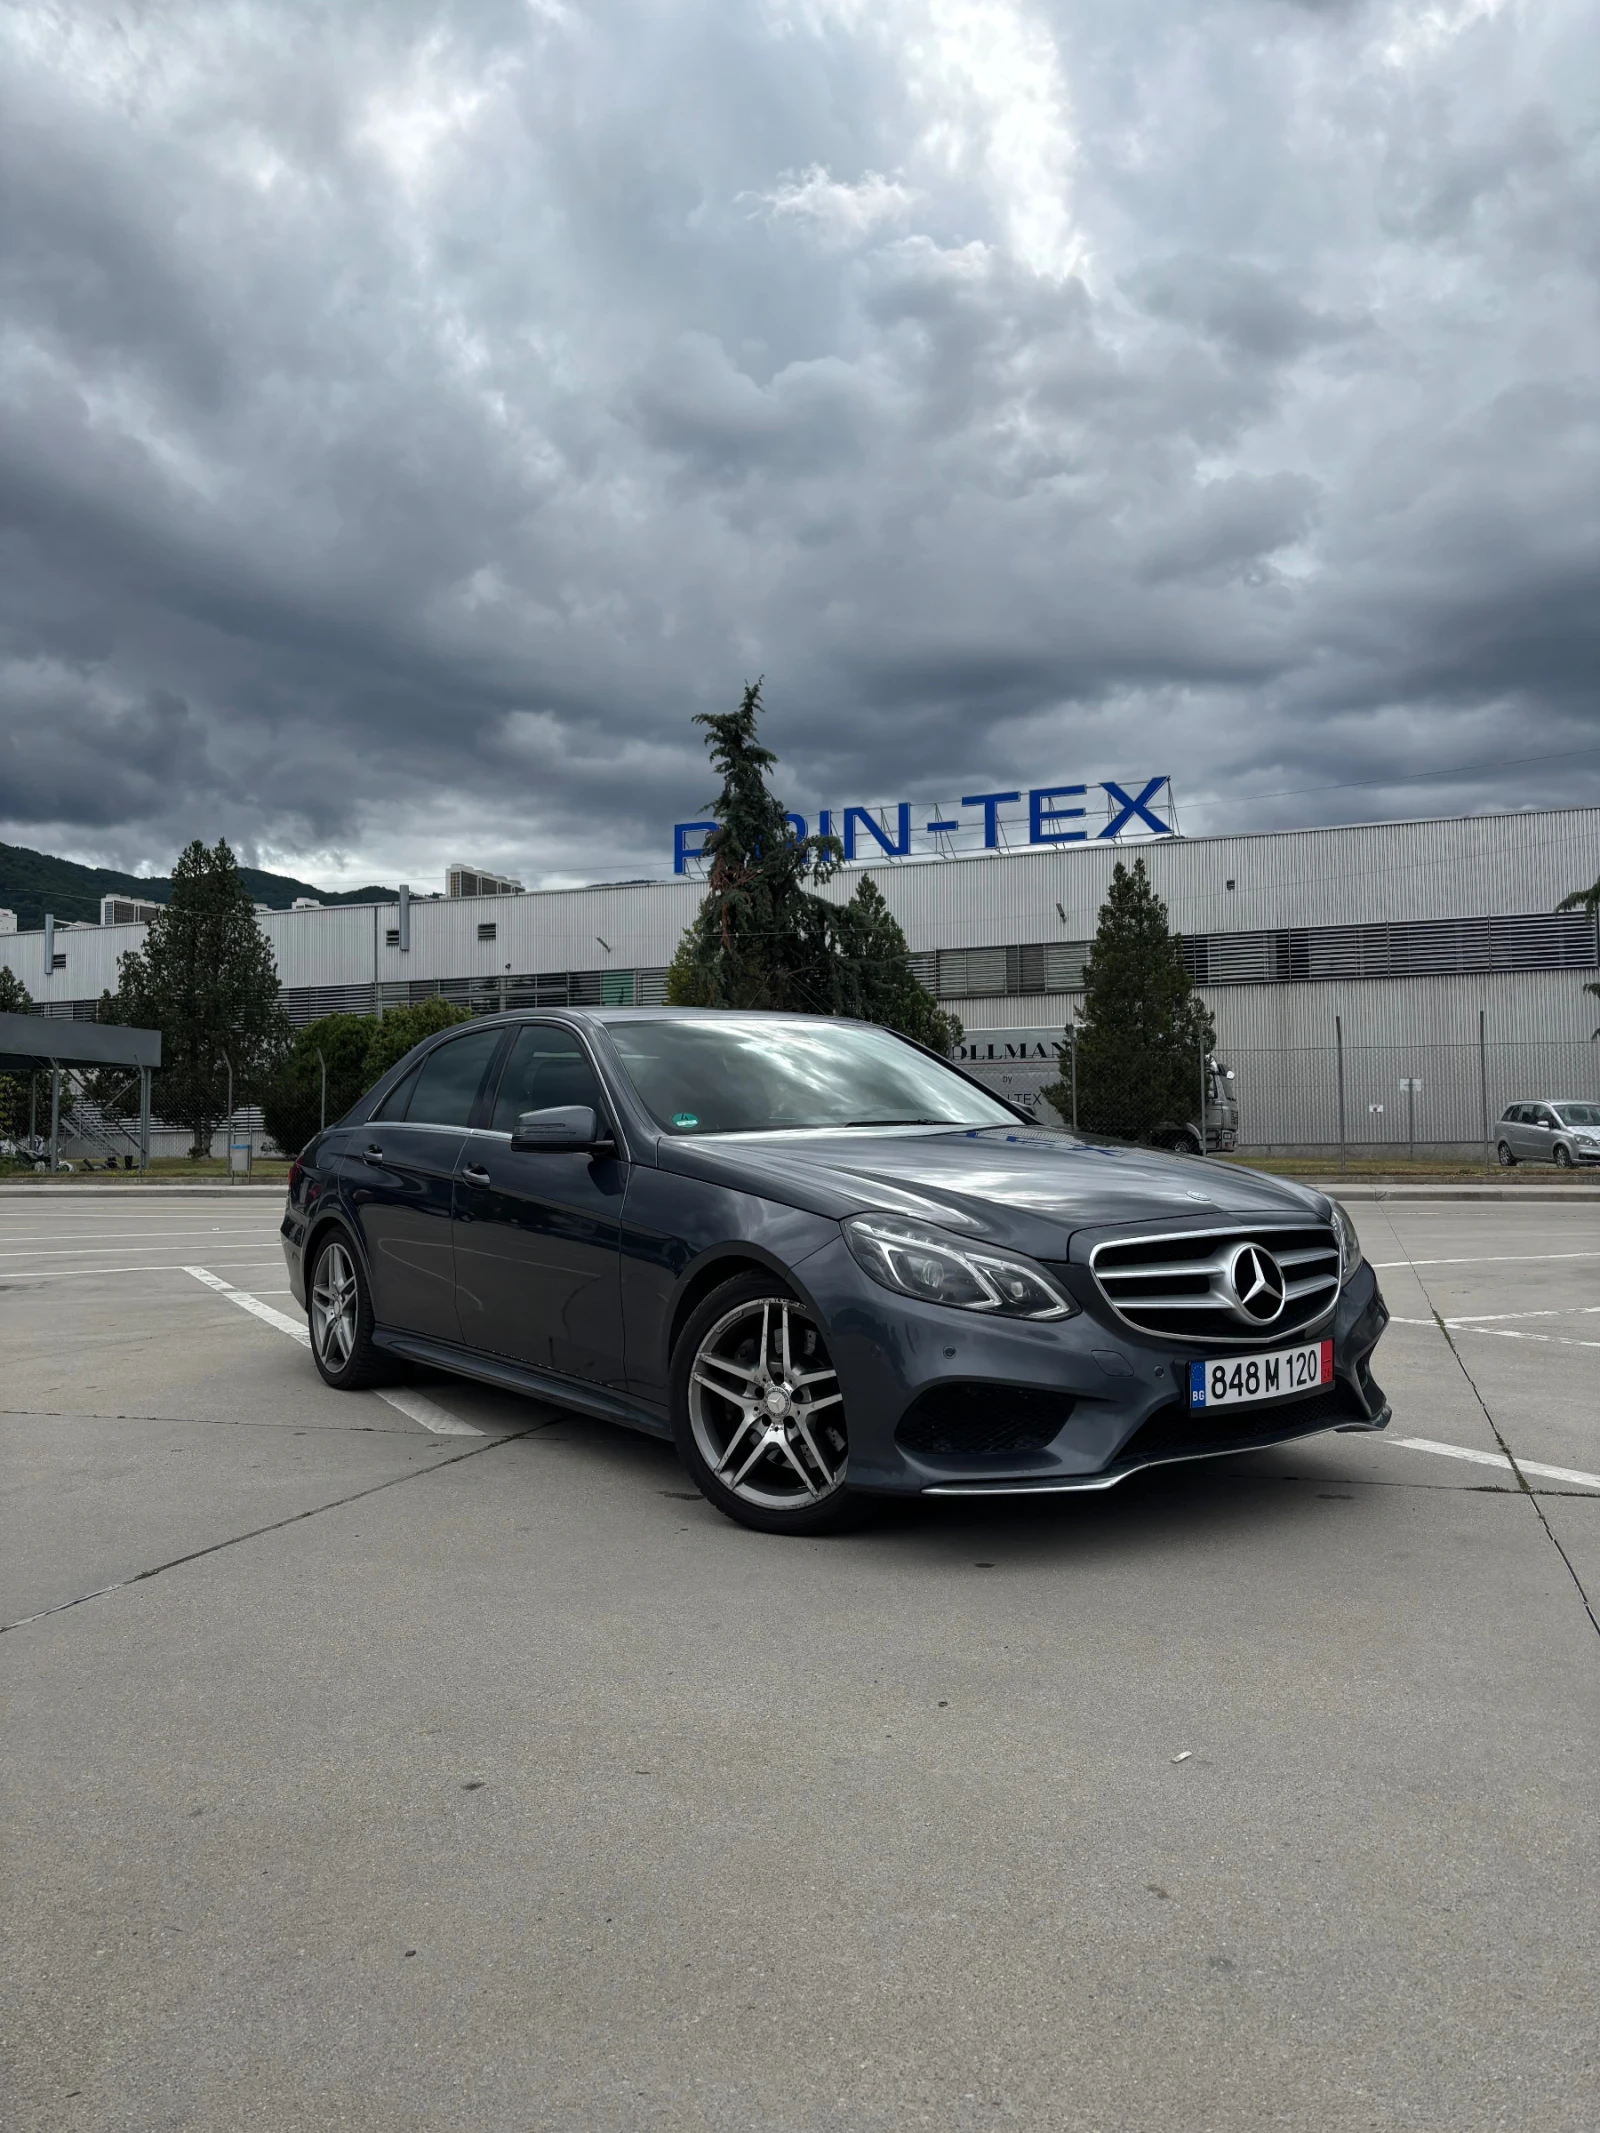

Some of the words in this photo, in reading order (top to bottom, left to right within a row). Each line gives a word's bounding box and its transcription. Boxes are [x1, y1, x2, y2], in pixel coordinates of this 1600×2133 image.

[673, 775, 1172, 875] PIN-TEX
[1003, 1075, 1012, 1084] by
[1192, 1391, 1205, 1401] BG
[1211, 1361, 1260, 1400] 848
[1265, 1357, 1280, 1393] M
[1286, 1349, 1317, 1388] 120
